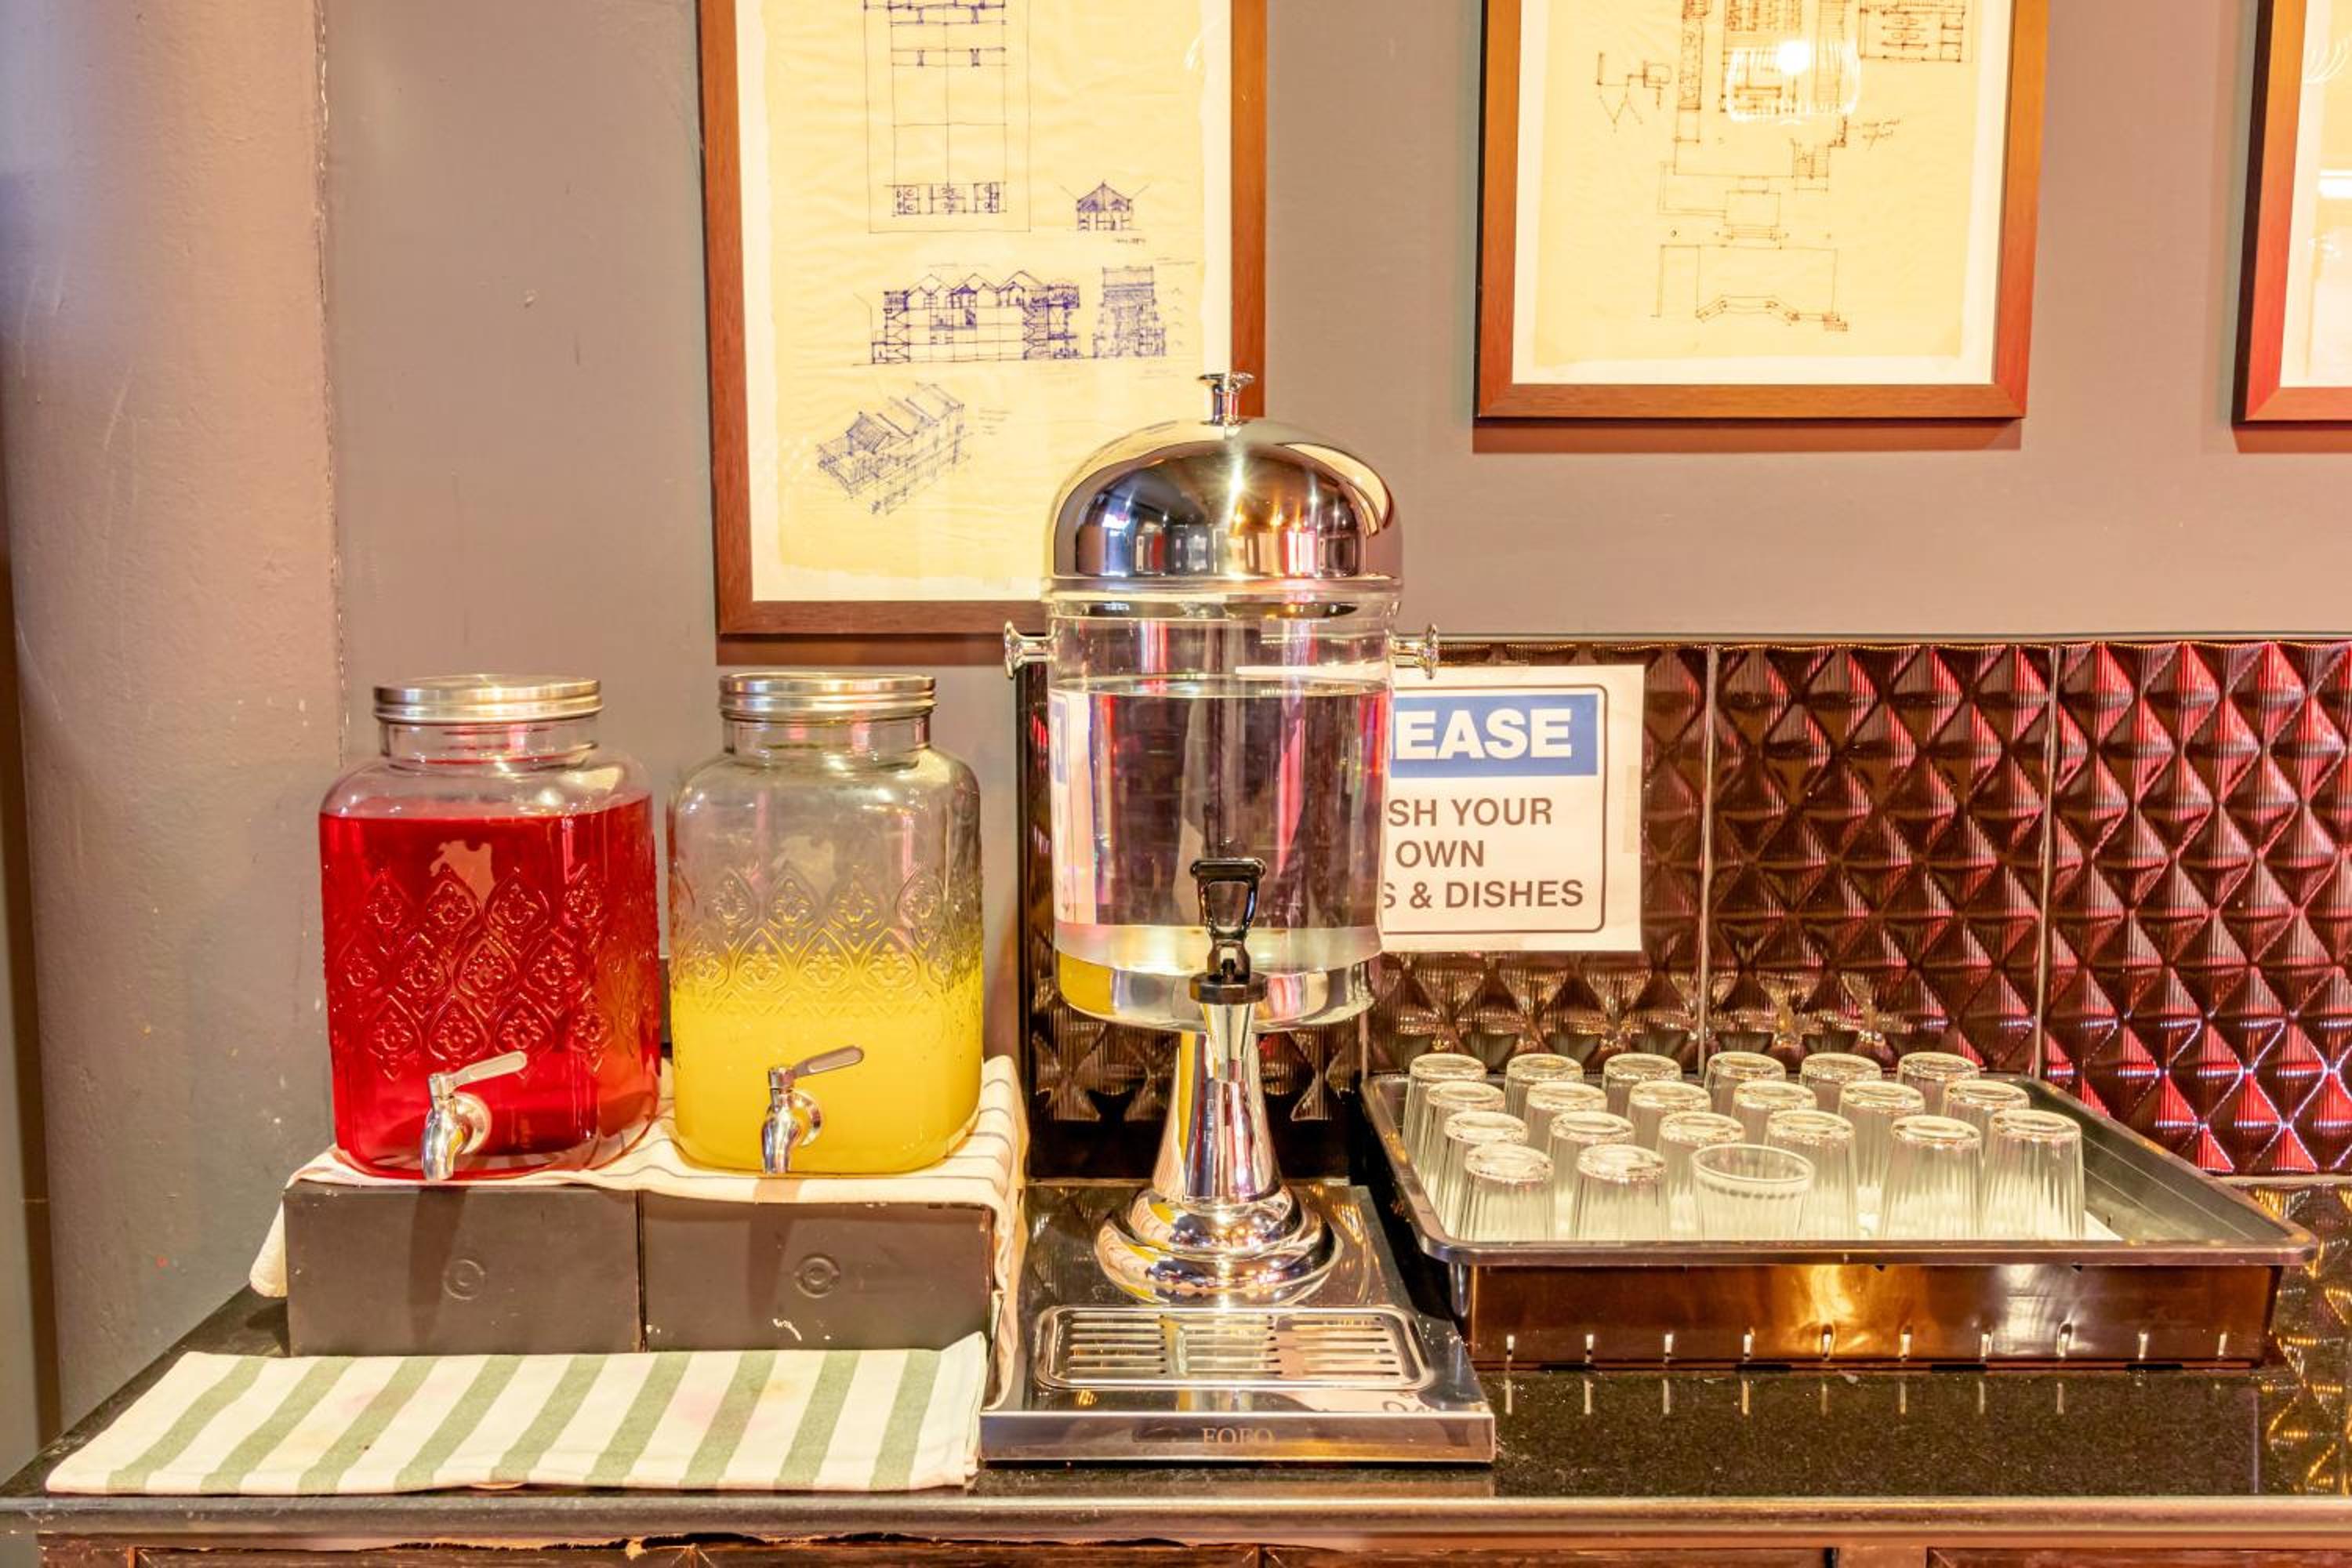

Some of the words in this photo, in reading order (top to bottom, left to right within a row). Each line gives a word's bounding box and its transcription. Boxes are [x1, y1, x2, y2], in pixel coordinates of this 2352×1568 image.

[1450, 797, 1553, 826] YOUR
[1395, 839, 1485, 869] OWN
[1408, 880, 1433, 909] &
[1445, 879, 1584, 909] DISHES
